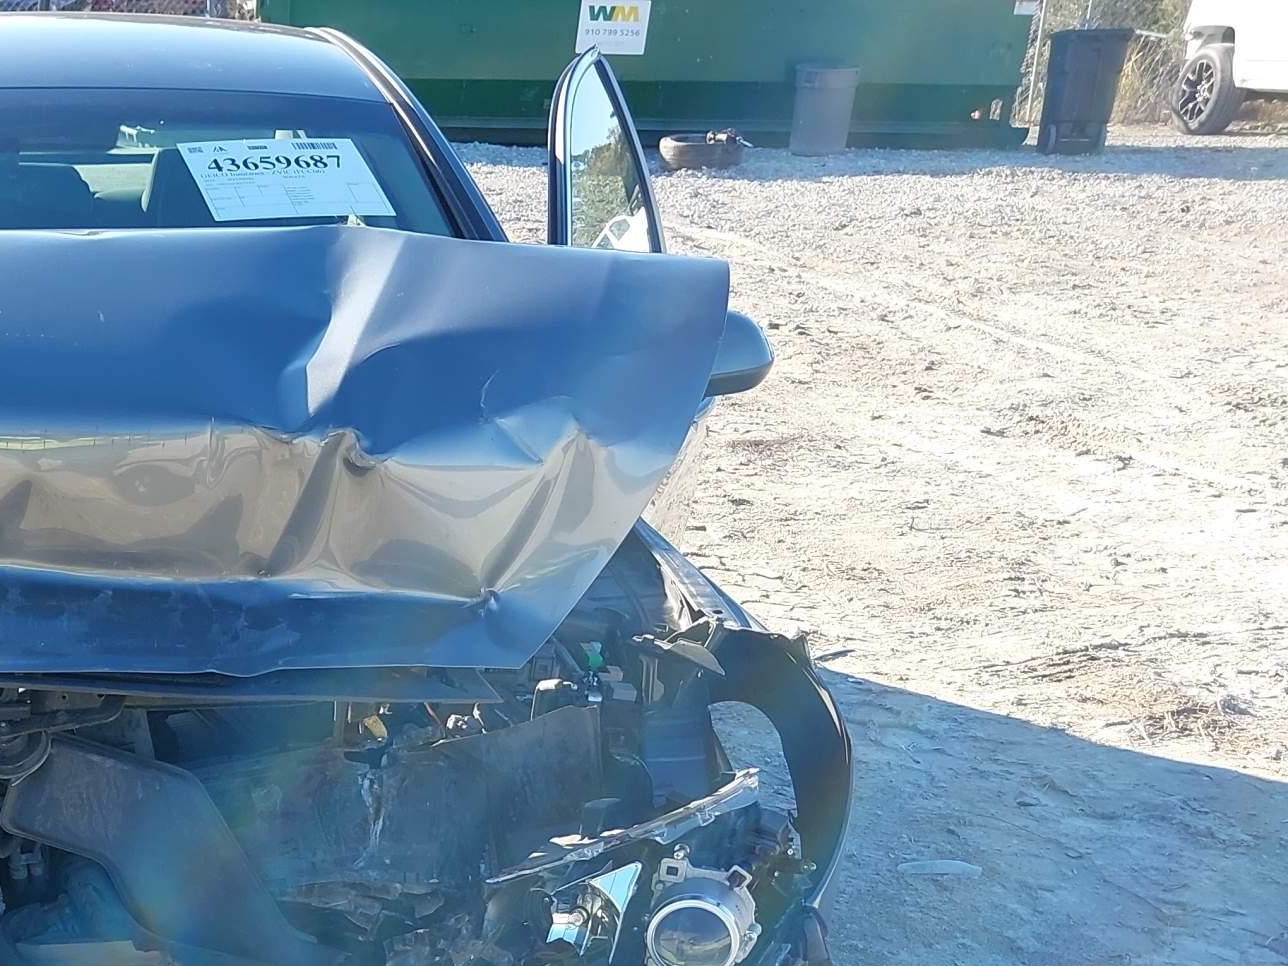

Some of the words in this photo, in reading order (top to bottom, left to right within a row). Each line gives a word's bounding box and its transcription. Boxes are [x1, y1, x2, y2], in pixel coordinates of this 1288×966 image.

[589, 5, 639, 21] WM
[619, 29, 640, 37] 5256
[208, 155, 341, 172] 43659687
